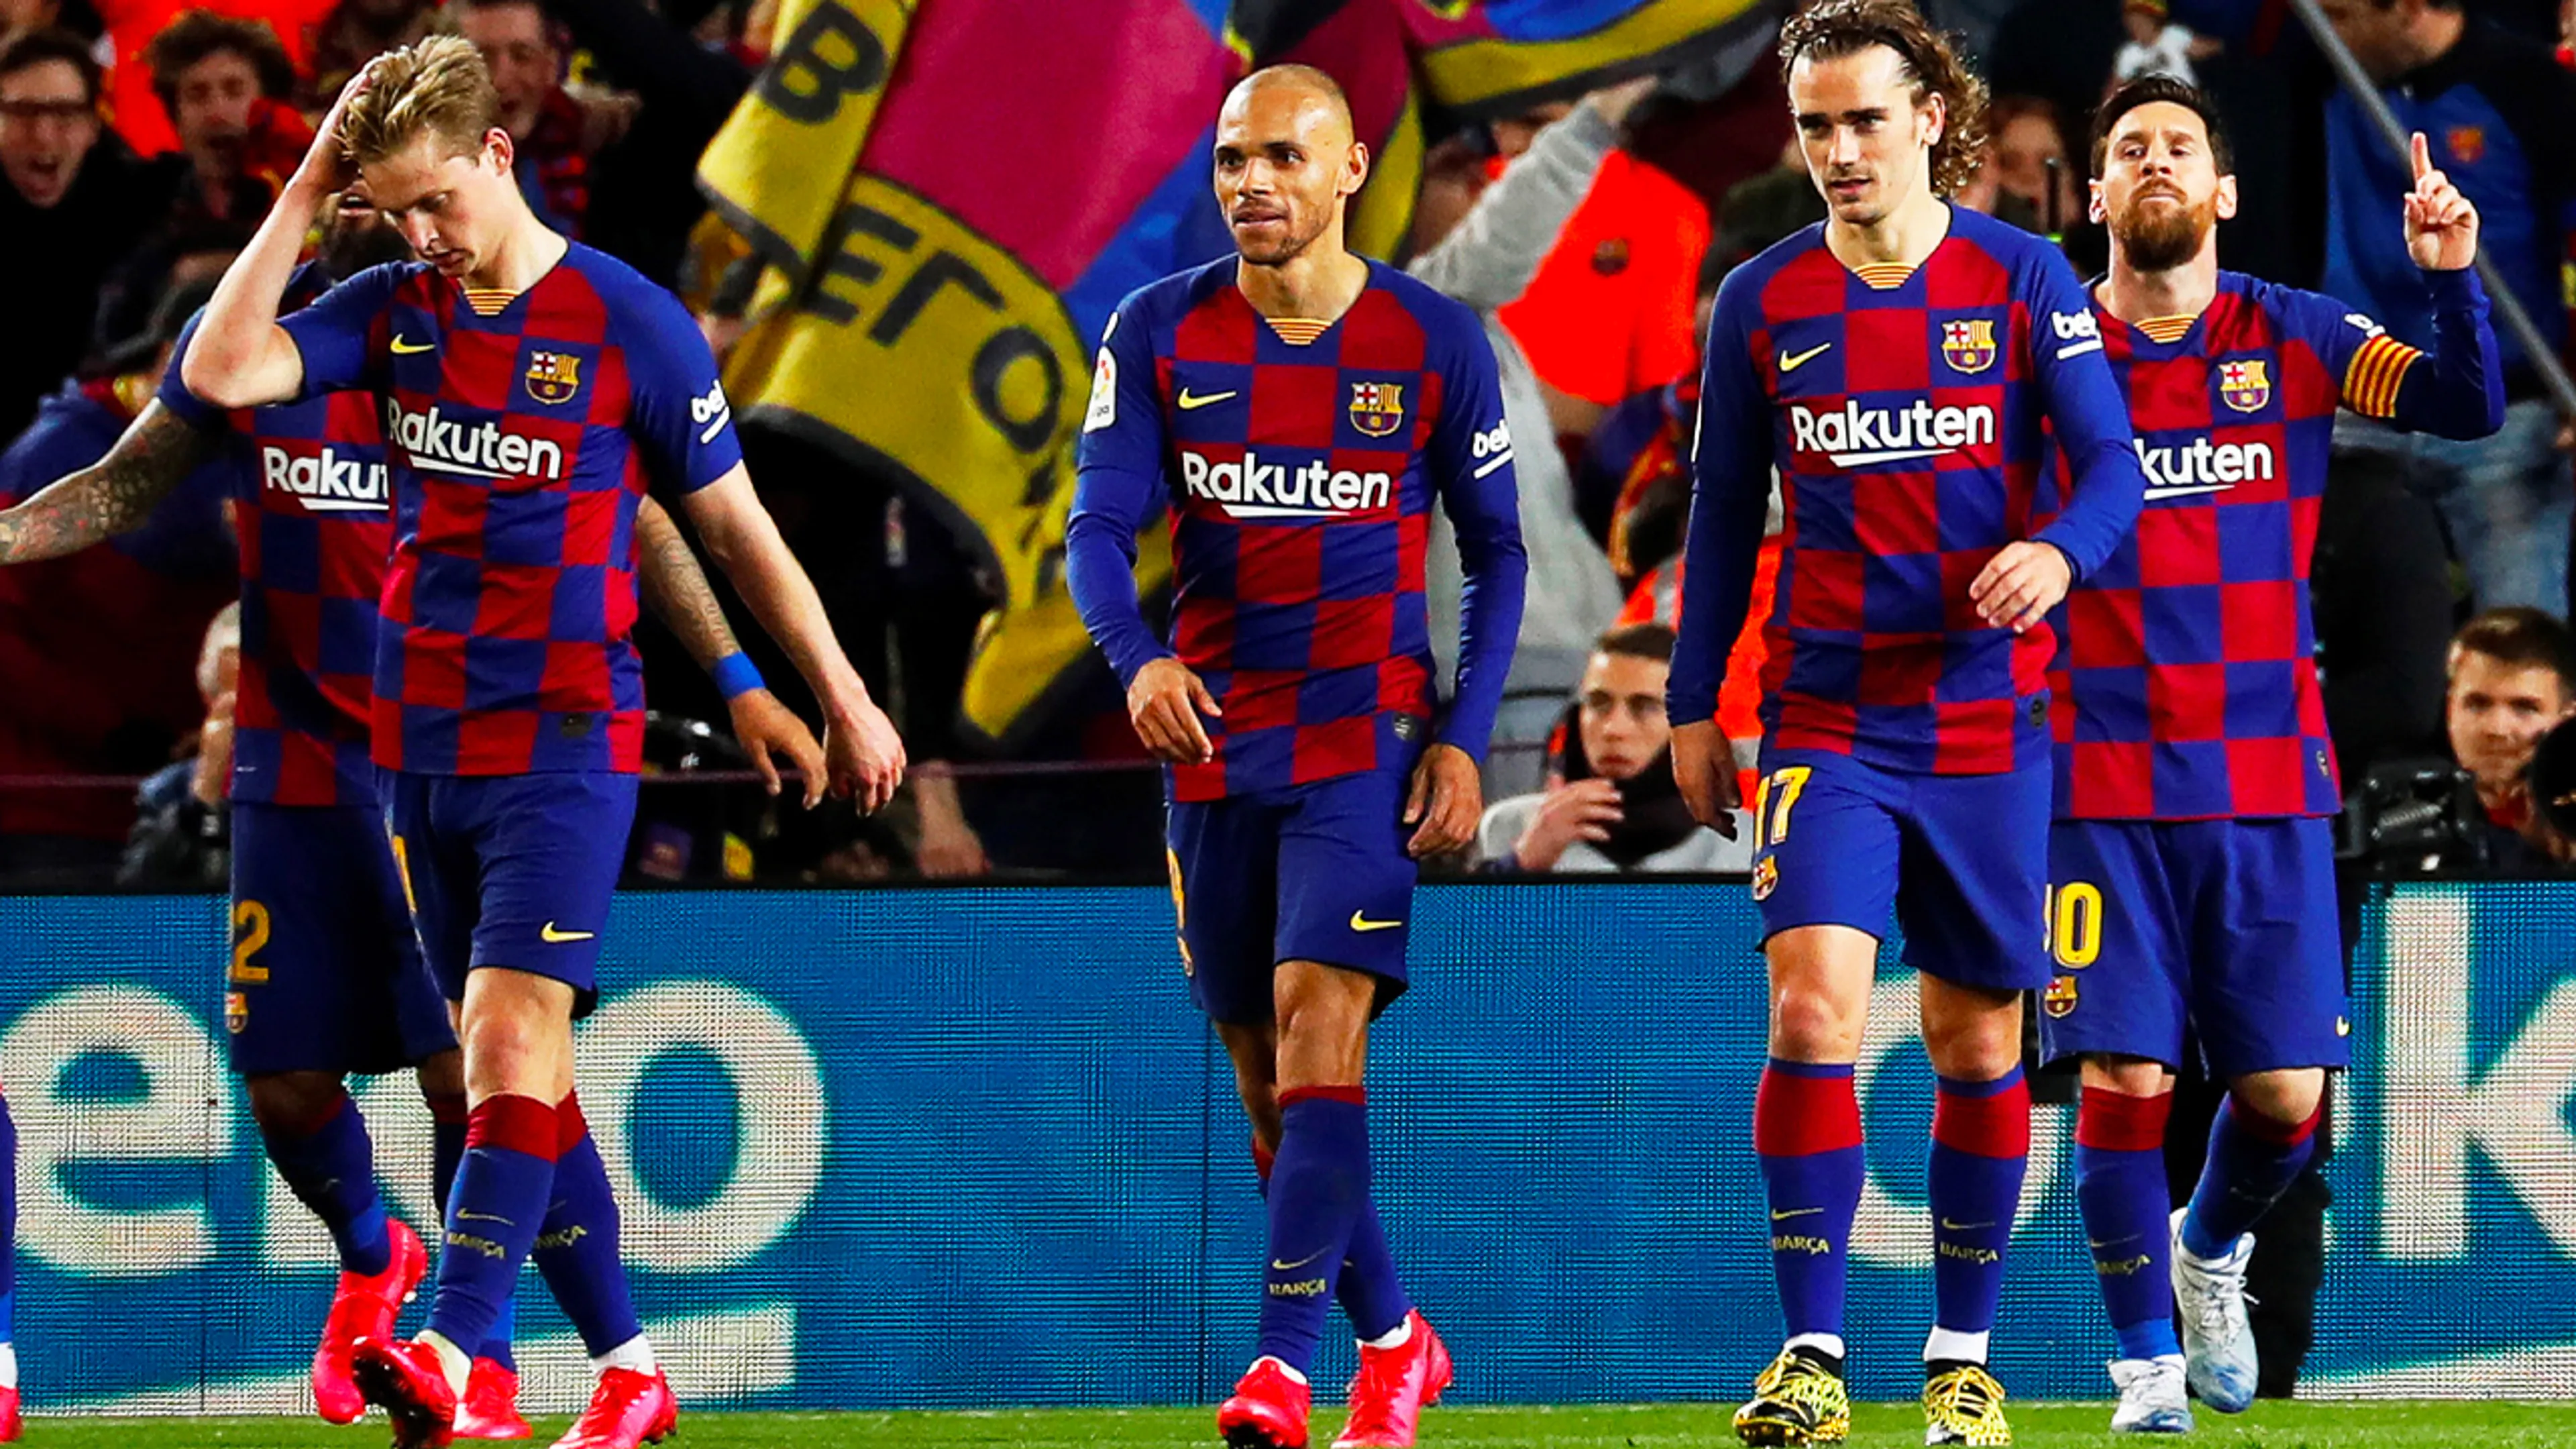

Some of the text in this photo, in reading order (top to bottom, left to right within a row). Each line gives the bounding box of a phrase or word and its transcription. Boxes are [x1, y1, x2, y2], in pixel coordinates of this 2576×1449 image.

[388, 397, 561, 479] Rakuten
[1790, 400, 1994, 452] Rakuten
[1182, 451, 1390, 510] Rakuten
[1755, 766, 1812, 853] 17
